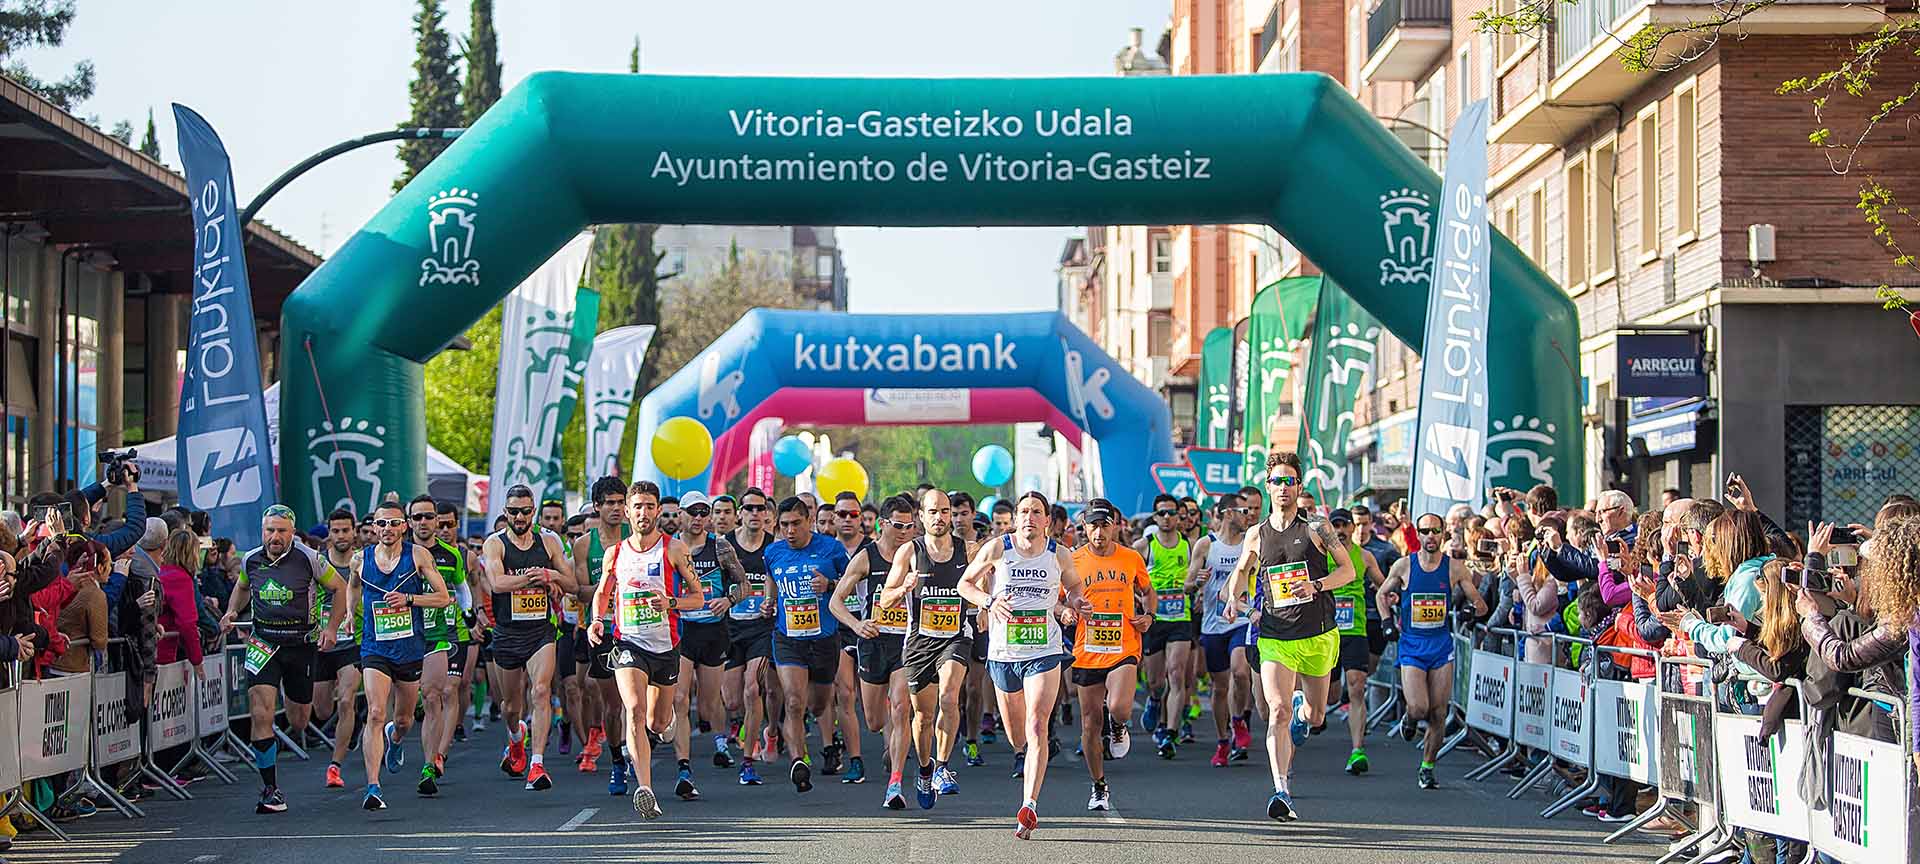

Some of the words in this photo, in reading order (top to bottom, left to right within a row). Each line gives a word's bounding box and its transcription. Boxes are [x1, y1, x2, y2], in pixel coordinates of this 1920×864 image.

[729, 108, 1024, 138] Vitoria-Gasteizko
[1035, 108, 1133, 138] Udala
[651, 151, 896, 186] Ayuntamiento
[907, 152, 948, 183] de
[959, 150, 1212, 183] Vitoria-Gasteiz
[1431, 183, 1473, 404] Lankide
[794, 332, 1018, 374] kutxabank
[1631, 358, 1696, 371] ARREGUI
[1011, 568, 1047, 579] INPRO
[521, 597, 547, 608] 3066
[1166, 602, 1182, 611] 642
[1422, 608, 1444, 618] 3514
[384, 613, 411, 629] 2505
[794, 613, 817, 625] 3341
[882, 610, 908, 622] 3055
[932, 614, 957, 626] 3791
[1020, 626, 1044, 640] 2118
[1095, 630, 1121, 641] 3530
[161, 684, 186, 720] CORREO
[1482, 676, 1506, 710] CORREO
[1525, 684, 1545, 718] CORREO
[1560, 697, 1583, 735] CORREO
[1834, 752, 1862, 801] VITORIA
[1748, 774, 1775, 815] GASTEIZ
[1833, 799, 1862, 846] GASTEIZ
